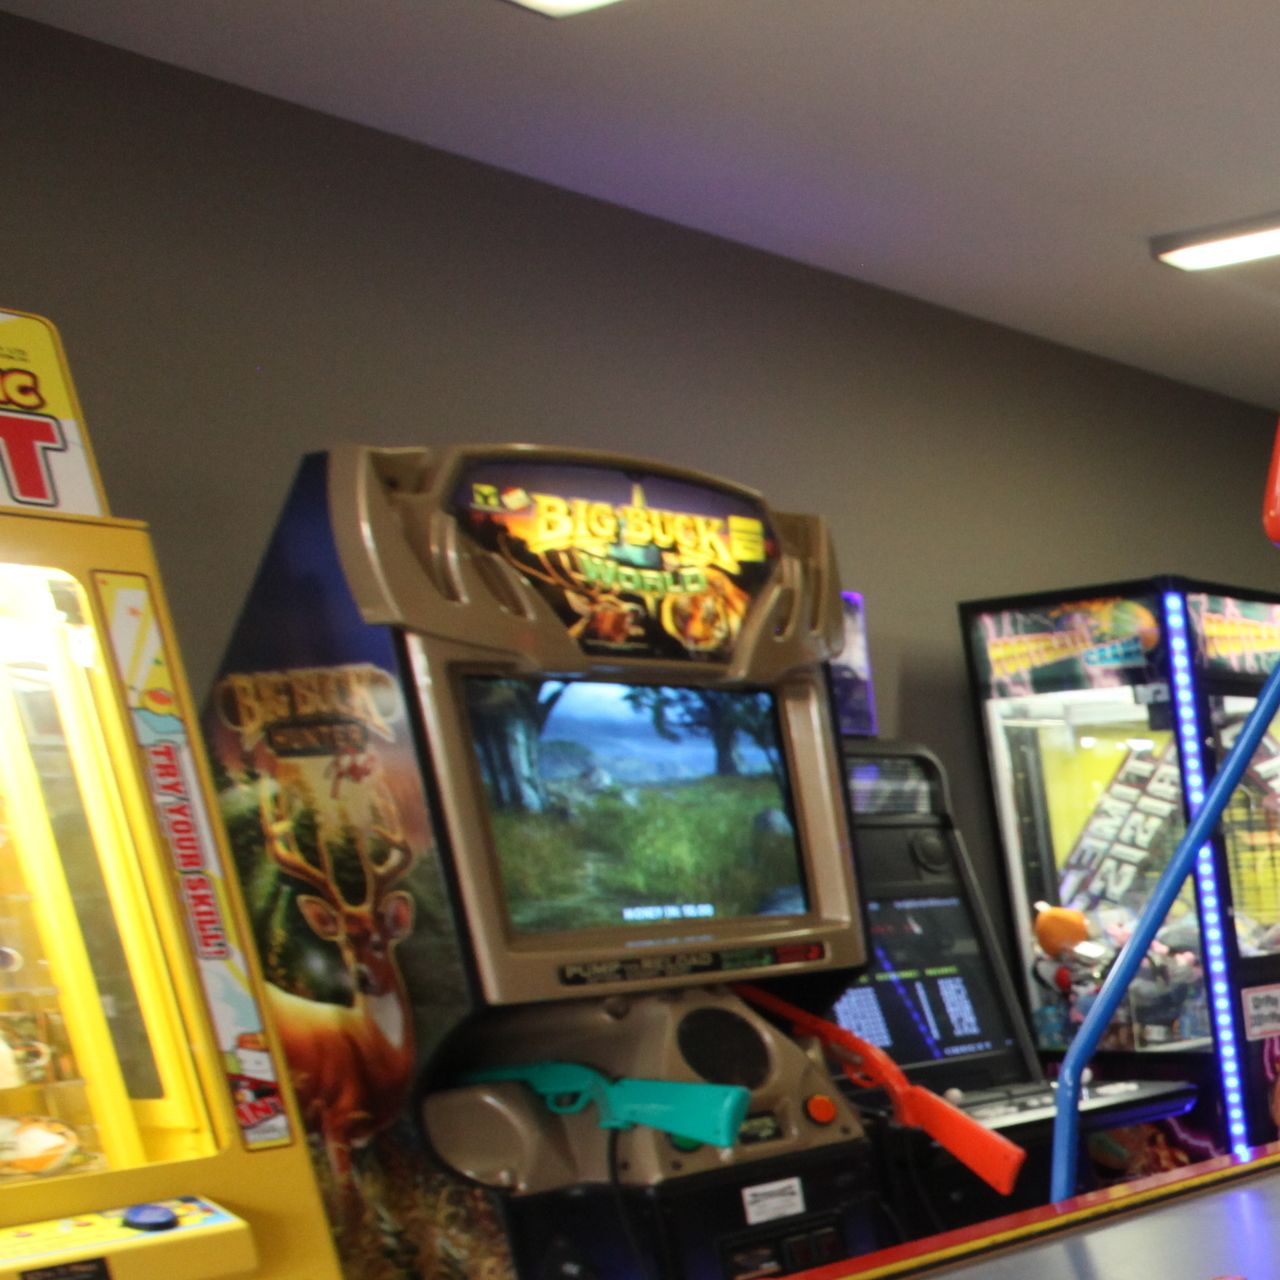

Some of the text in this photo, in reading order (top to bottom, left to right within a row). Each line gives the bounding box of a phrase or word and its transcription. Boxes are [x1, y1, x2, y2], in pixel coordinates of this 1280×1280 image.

[530, 494, 618, 552] BIG
[624, 502, 742, 574] BUCK
[577, 552, 708, 593] WORLD
[152, 745, 182, 795] TRY
[168, 804, 204, 868] YOUR
